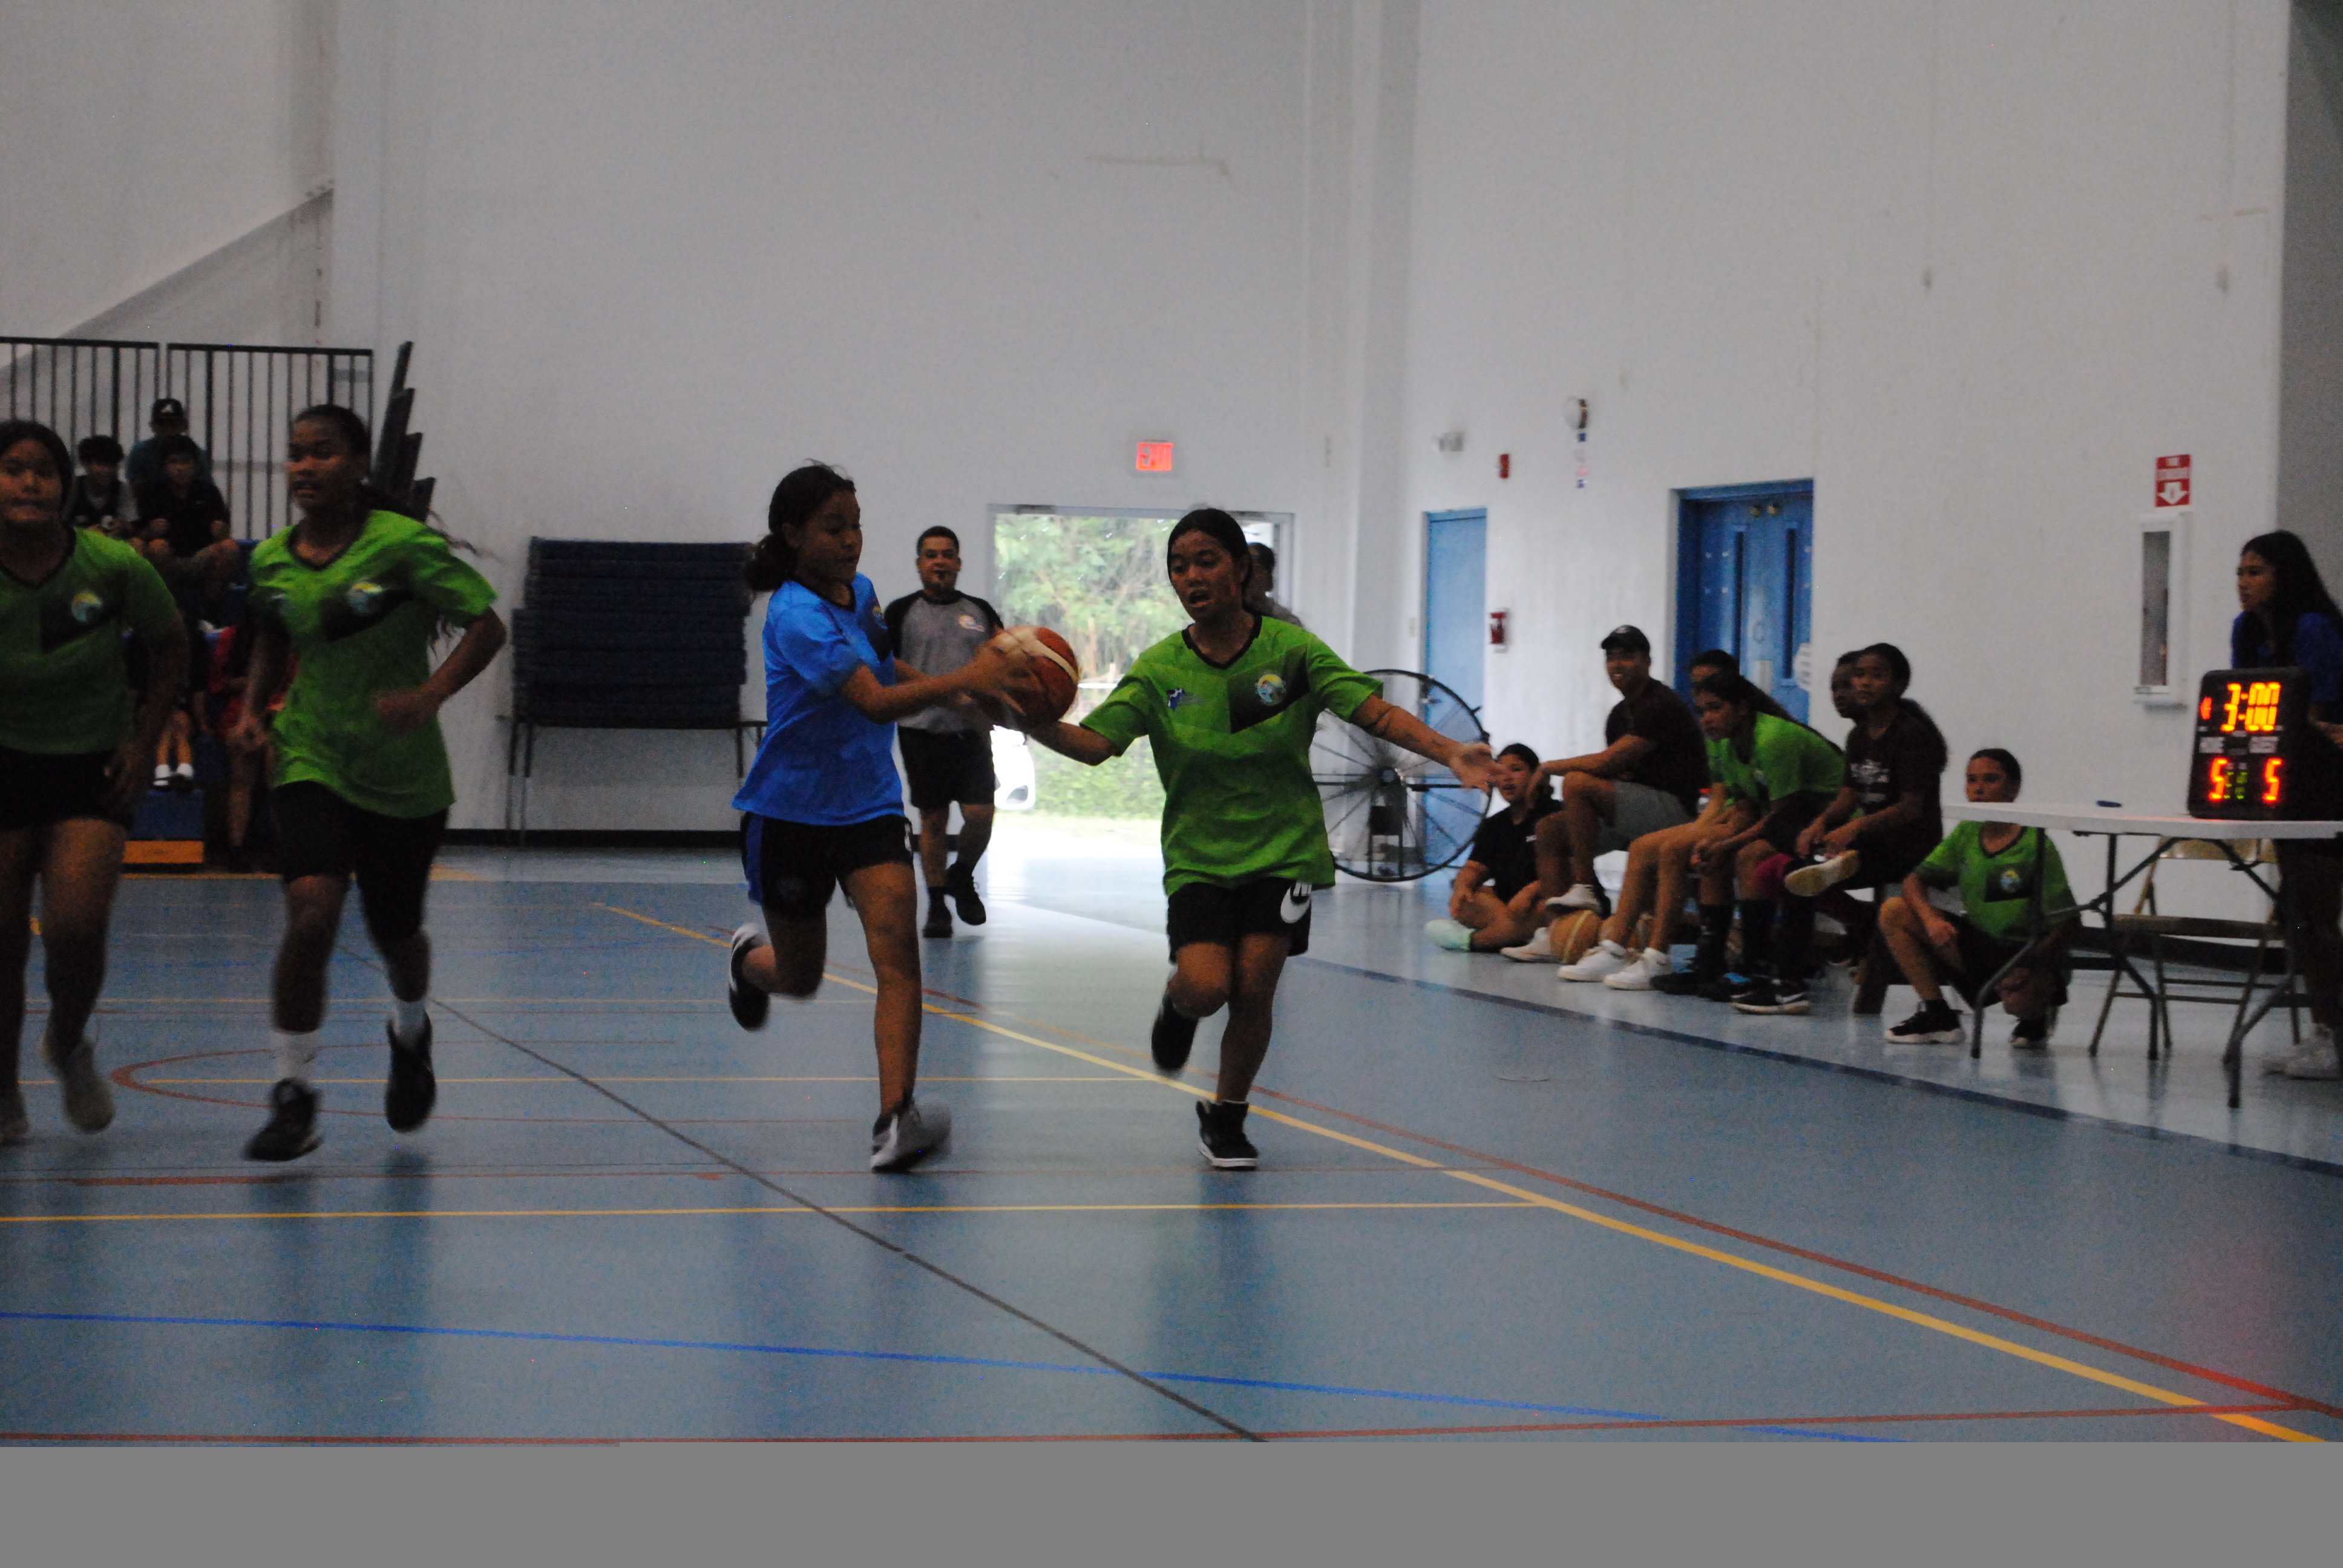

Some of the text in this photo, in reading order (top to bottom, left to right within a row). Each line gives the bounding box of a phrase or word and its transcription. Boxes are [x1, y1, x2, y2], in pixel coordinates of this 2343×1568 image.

[2220, 682, 2281, 731] 3:00
[2209, 758, 2228, 801] 5
[2263, 759, 2282, 802] 5
